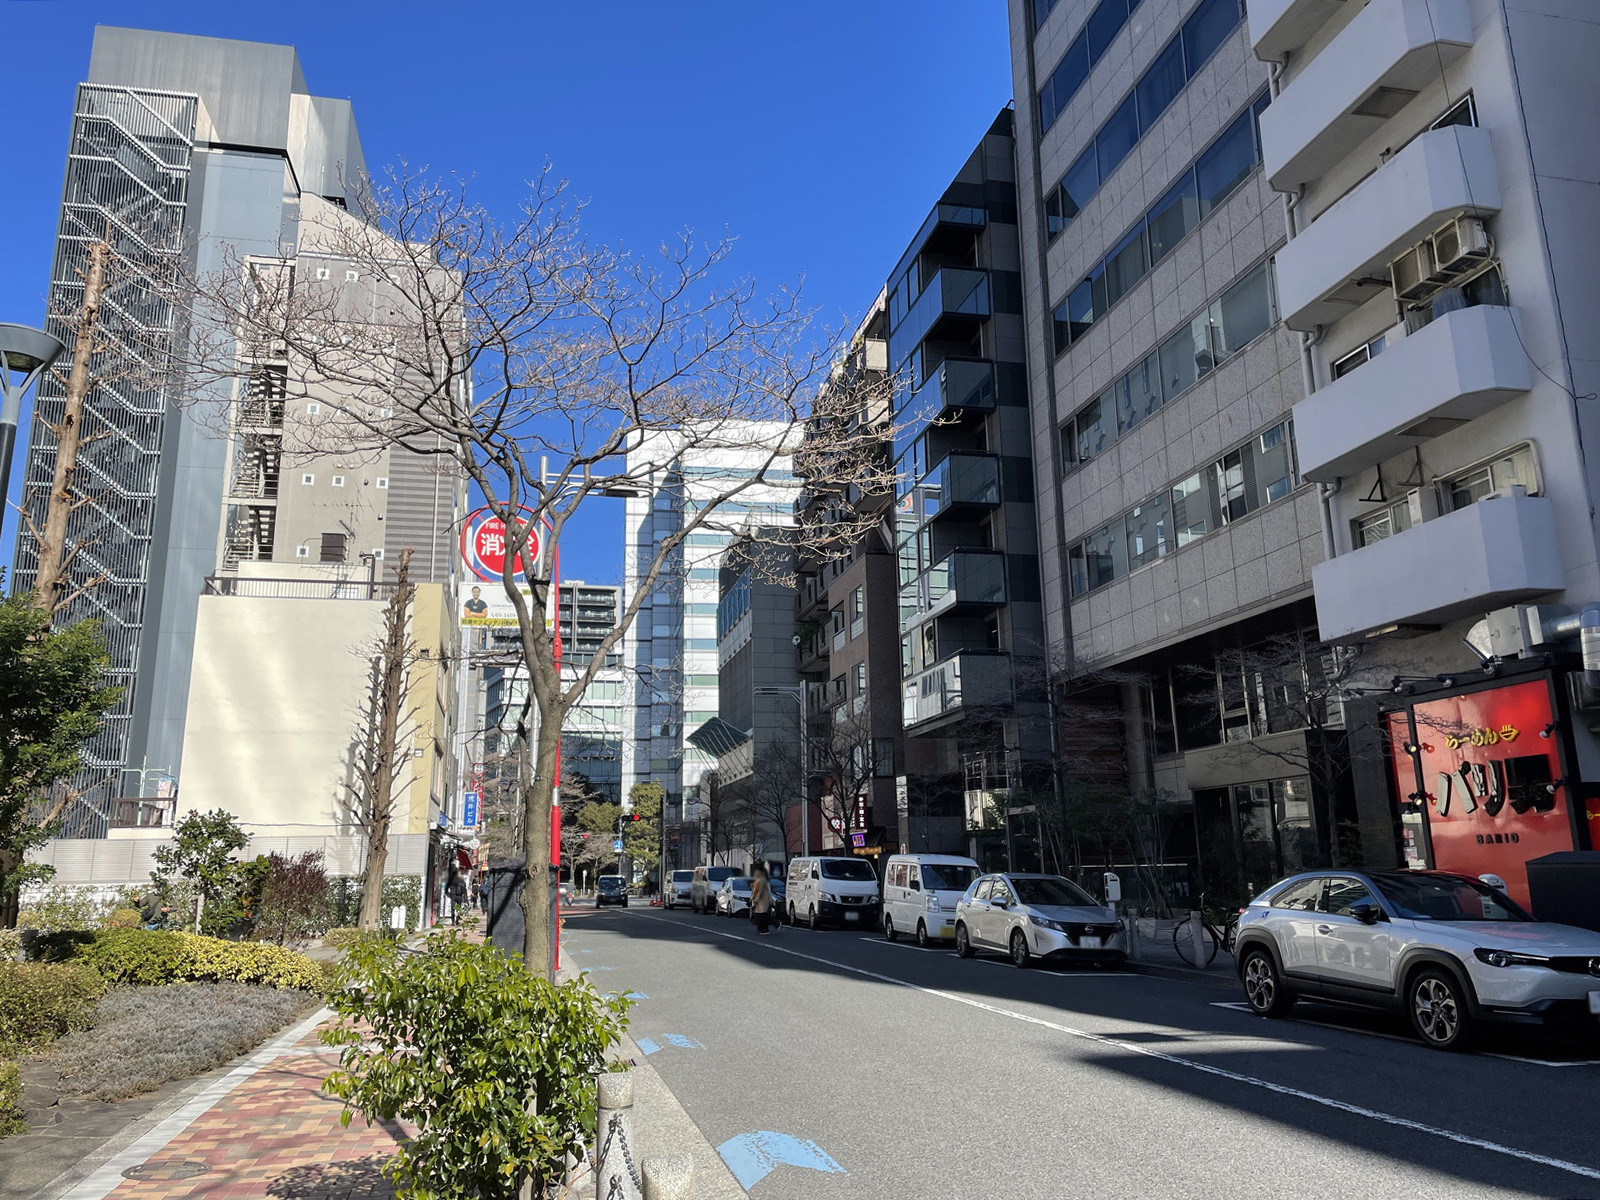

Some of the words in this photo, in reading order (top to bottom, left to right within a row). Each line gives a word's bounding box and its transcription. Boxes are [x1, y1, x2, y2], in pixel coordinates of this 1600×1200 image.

[486, 522, 499, 530] FIRE
[1445, 727, 1498, 749] らーめん
[1476, 830, 1519, 845] BARIO
